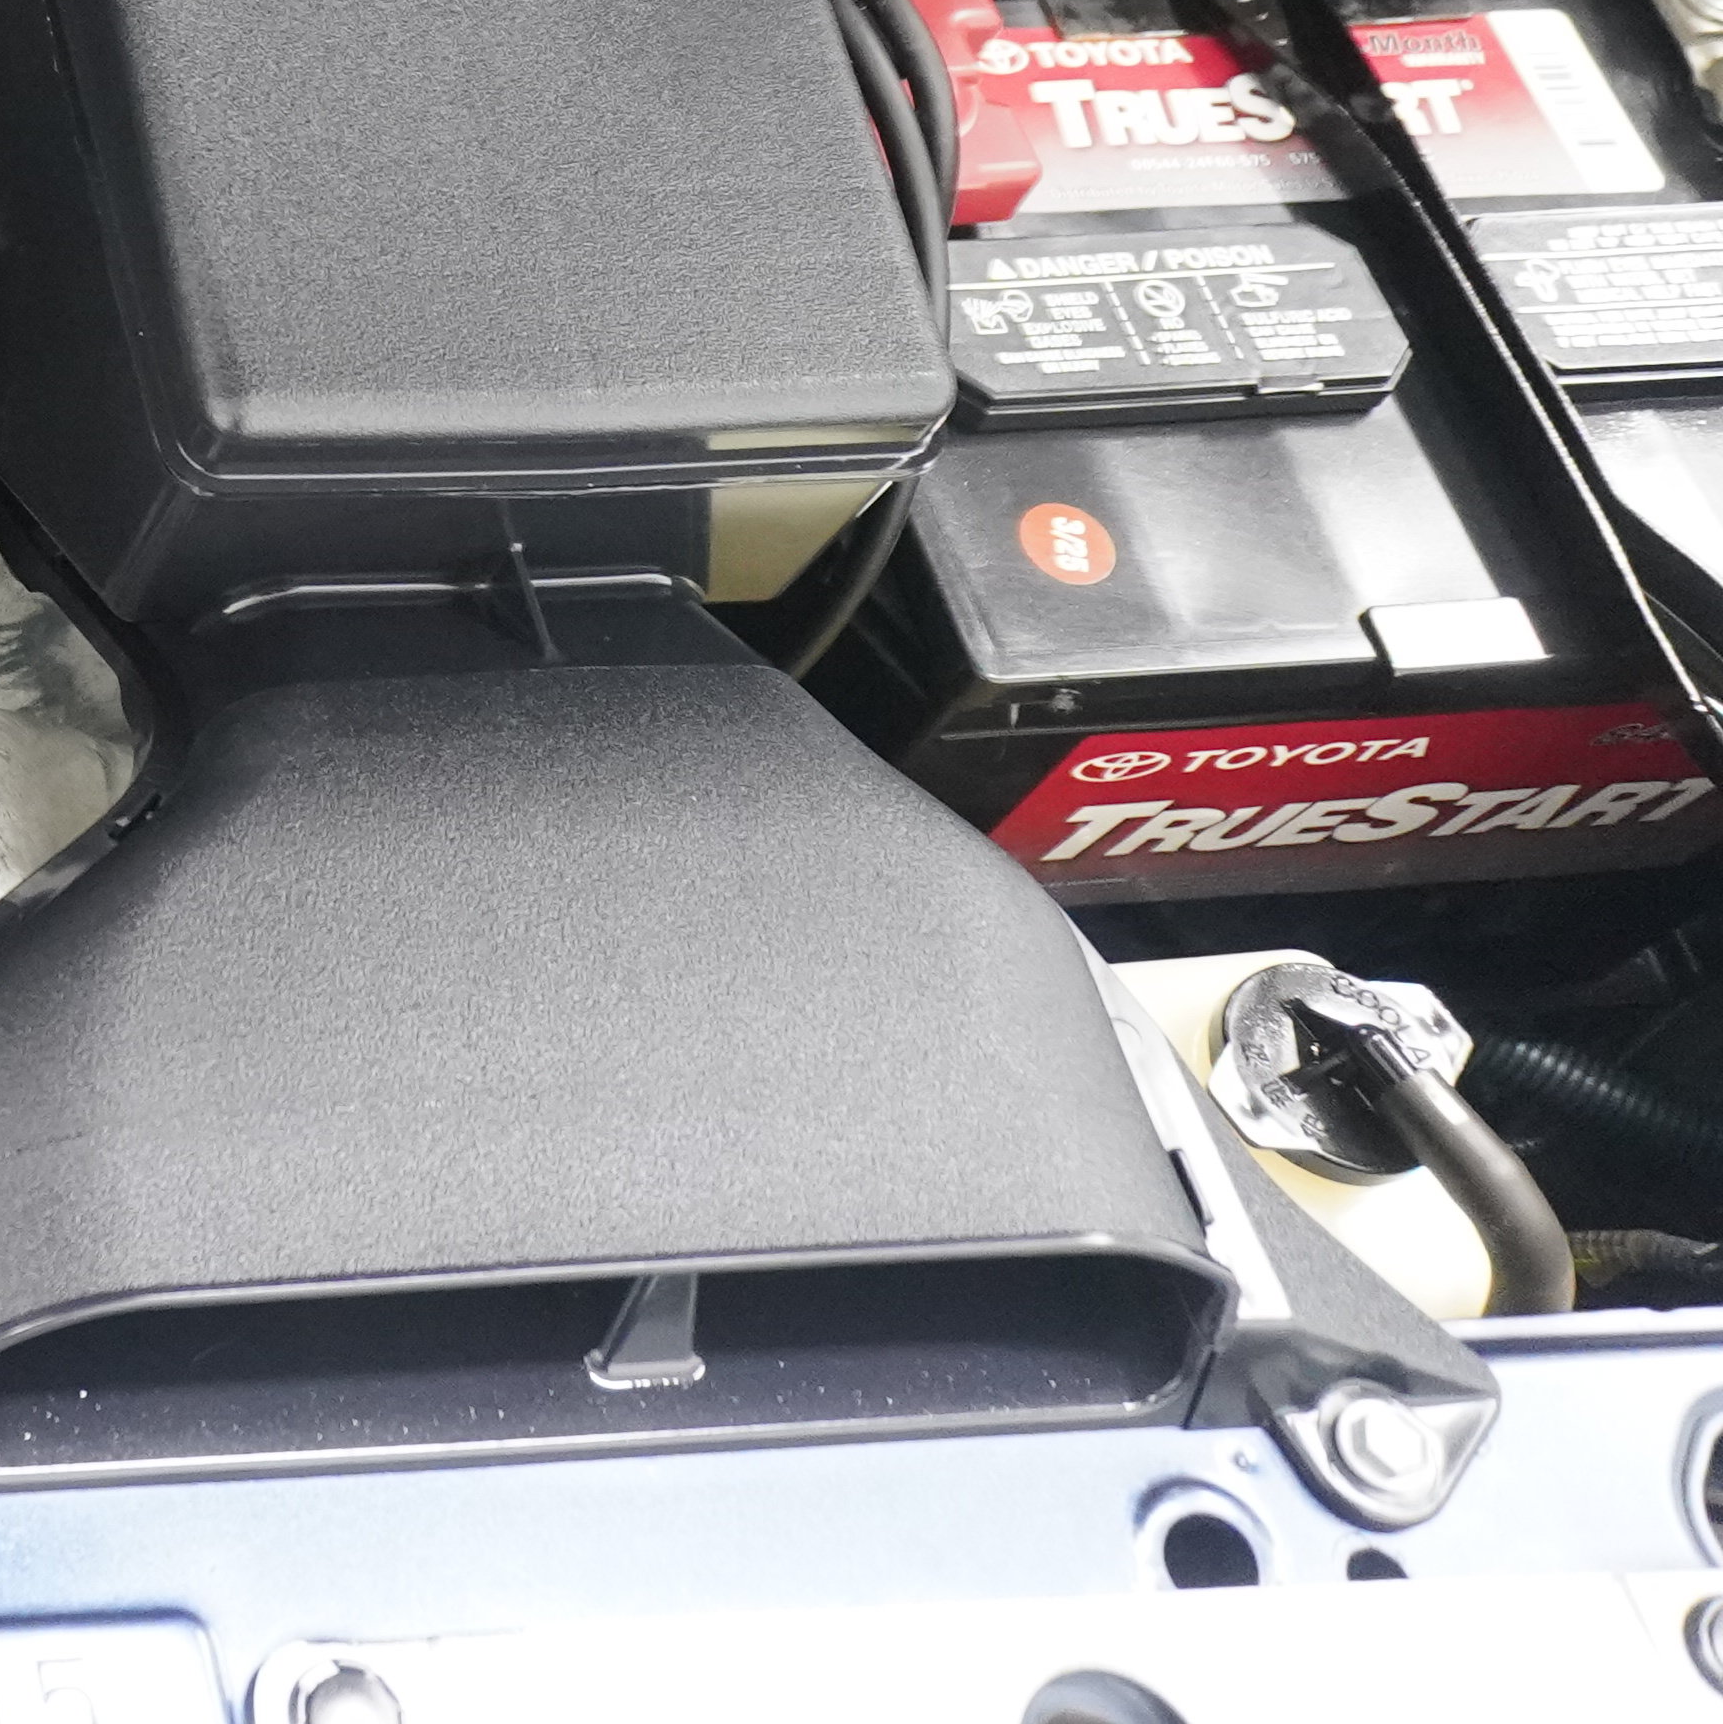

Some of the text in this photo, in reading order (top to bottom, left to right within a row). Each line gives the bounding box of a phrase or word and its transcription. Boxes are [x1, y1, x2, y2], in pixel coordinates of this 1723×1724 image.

[1029, 38, 1195, 68] TOYOTA
[1013, 251, 1140, 279] DANGER
[1160, 244, 1276, 270] POISON
[1039, 290, 1100, 307] SHIELD
[1020, 317, 1107, 336] EXPLOSIVE
[1181, 735, 1430, 776] TOYOTA
